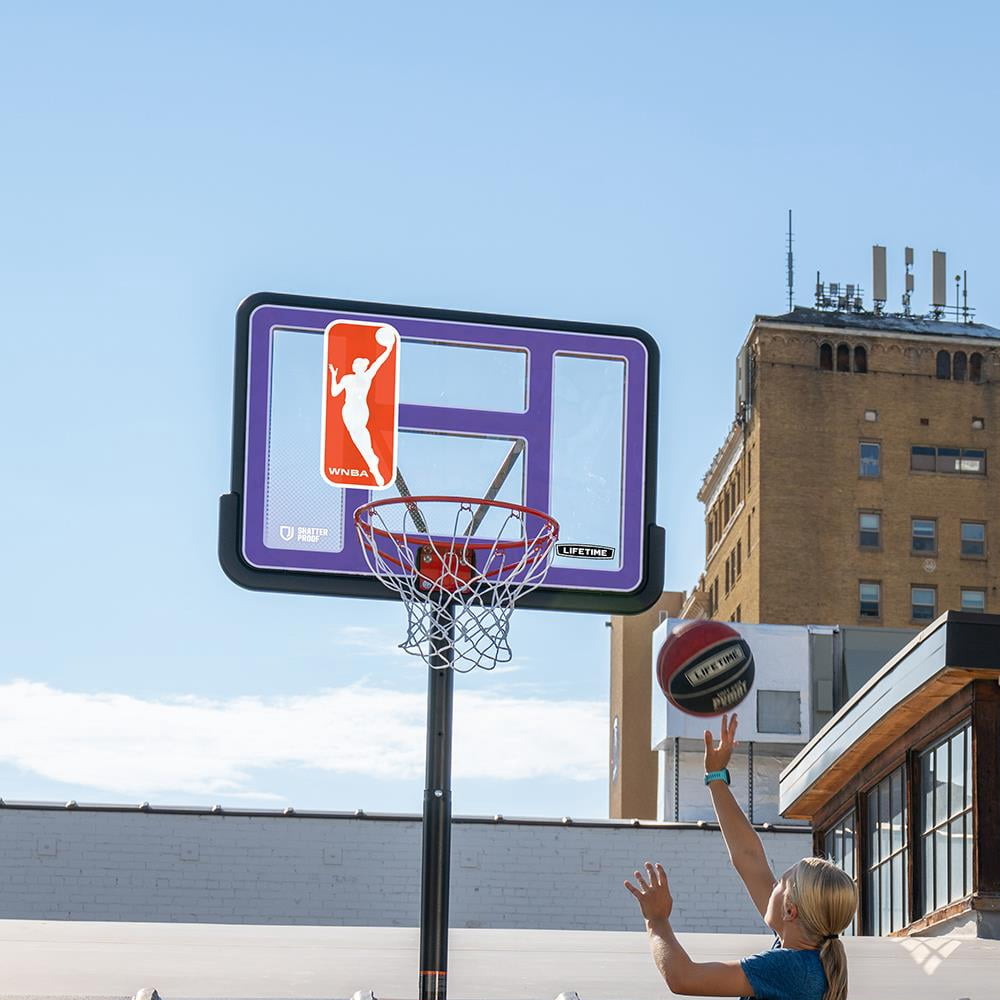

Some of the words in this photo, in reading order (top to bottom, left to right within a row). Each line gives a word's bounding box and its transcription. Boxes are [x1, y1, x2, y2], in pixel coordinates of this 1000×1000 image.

[328, 467, 369, 477] WNBA
[297, 527, 329, 536] SHATTER
[297, 535, 320, 543] PROOF
[563, 547, 608, 557] LIFETIME
[693, 648, 739, 680] LIFETIME
